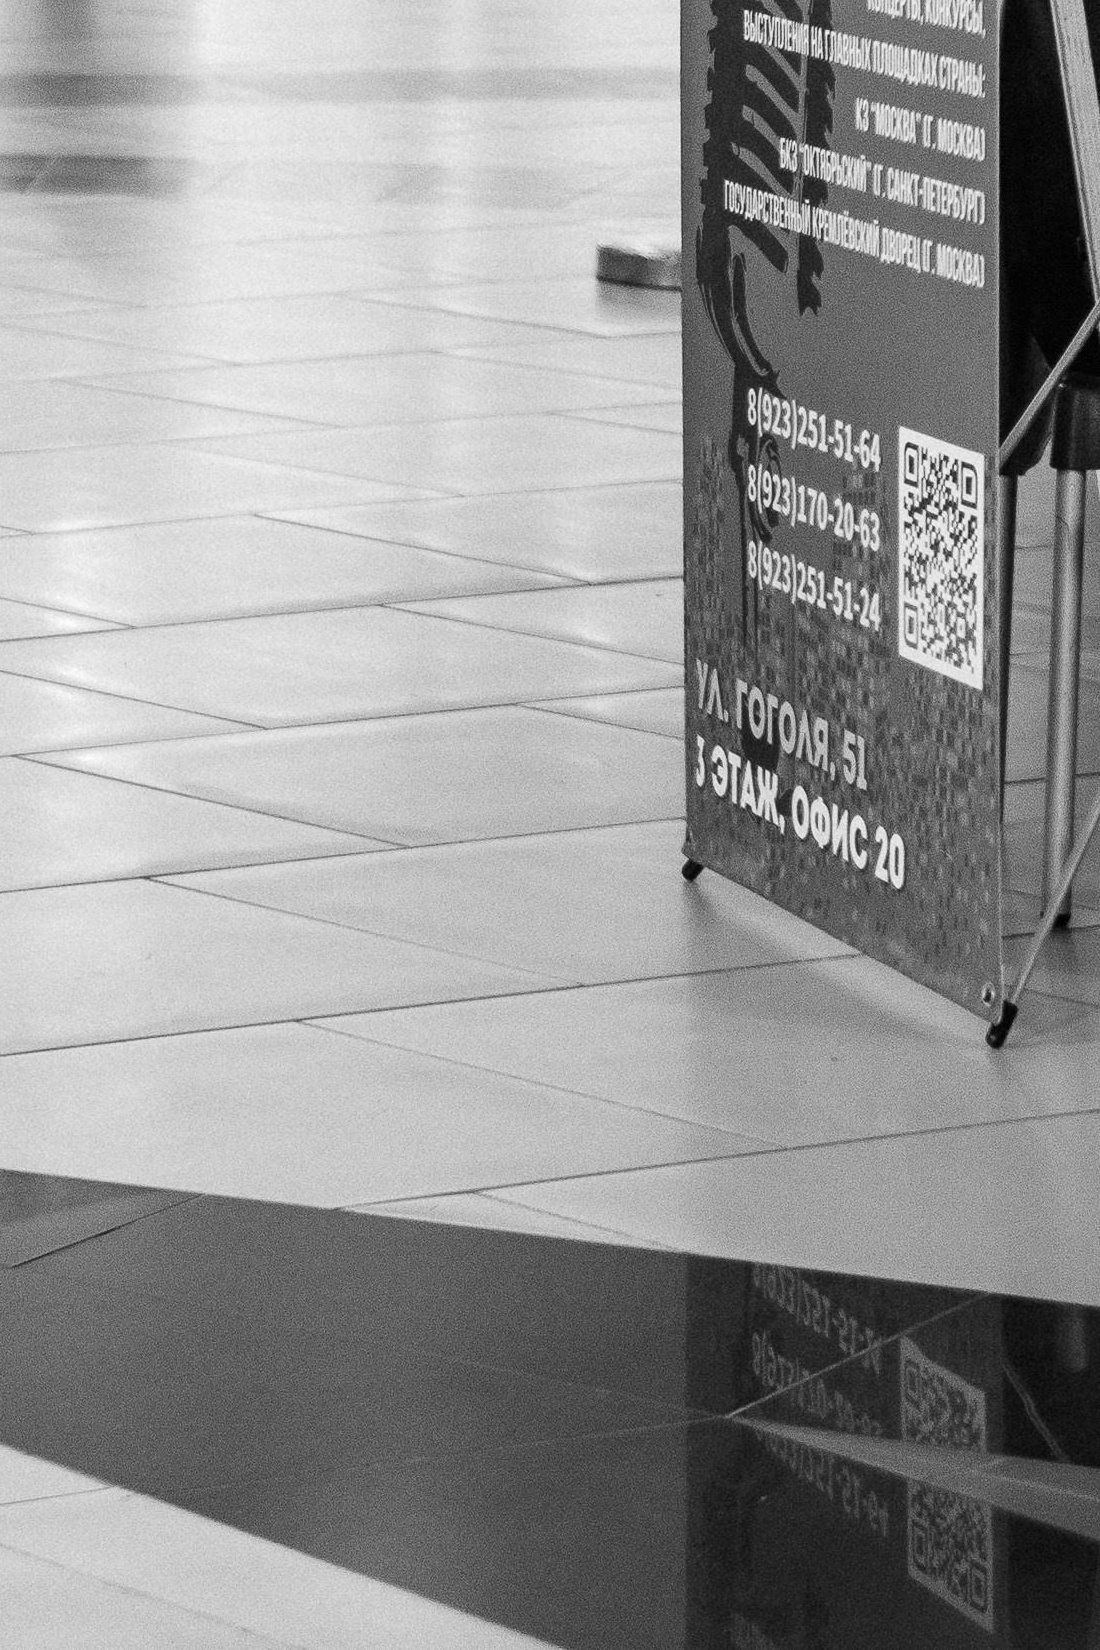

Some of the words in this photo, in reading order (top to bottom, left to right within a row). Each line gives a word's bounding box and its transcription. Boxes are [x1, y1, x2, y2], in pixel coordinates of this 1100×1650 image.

[743, 9, 809, 56] ВЫСТУПЛЕНИЯ
[810, 25, 823, 60] НА
[824, 29, 871, 72] ГЛАВНЫХ
[872, 40, 938, 87] ПЛОЩАДКАХ
[939, 55, 986, 99] СТРАНЫ:
[779, 137, 798, 173] БКЗ
[855, 96, 869, 132] КЗ
[870, 101, 921, 145] "МОСКВА"
[724, 179, 811, 236] ГОСУДАРСТВЕННЫЙ
[880, 227, 921, 274] ДВОРЕЦ
[747, 386, 881, 473] 8(923)251-51-64
[747, 463, 881, 552] 8(923)170-20-63
[747, 540, 881, 632] 8(923)251-51-24
[696, 657, 729, 723] УЛ.
[736, 678, 836, 781] ГОГОЛЯ,
[843, 729, 868, 791] 51
[696, 734, 706, 788] 3
[711, 745, 786, 836] ЭТАЖ,
[791, 785, 869, 870] ОФИС
[875, 825, 905, 890] 20
